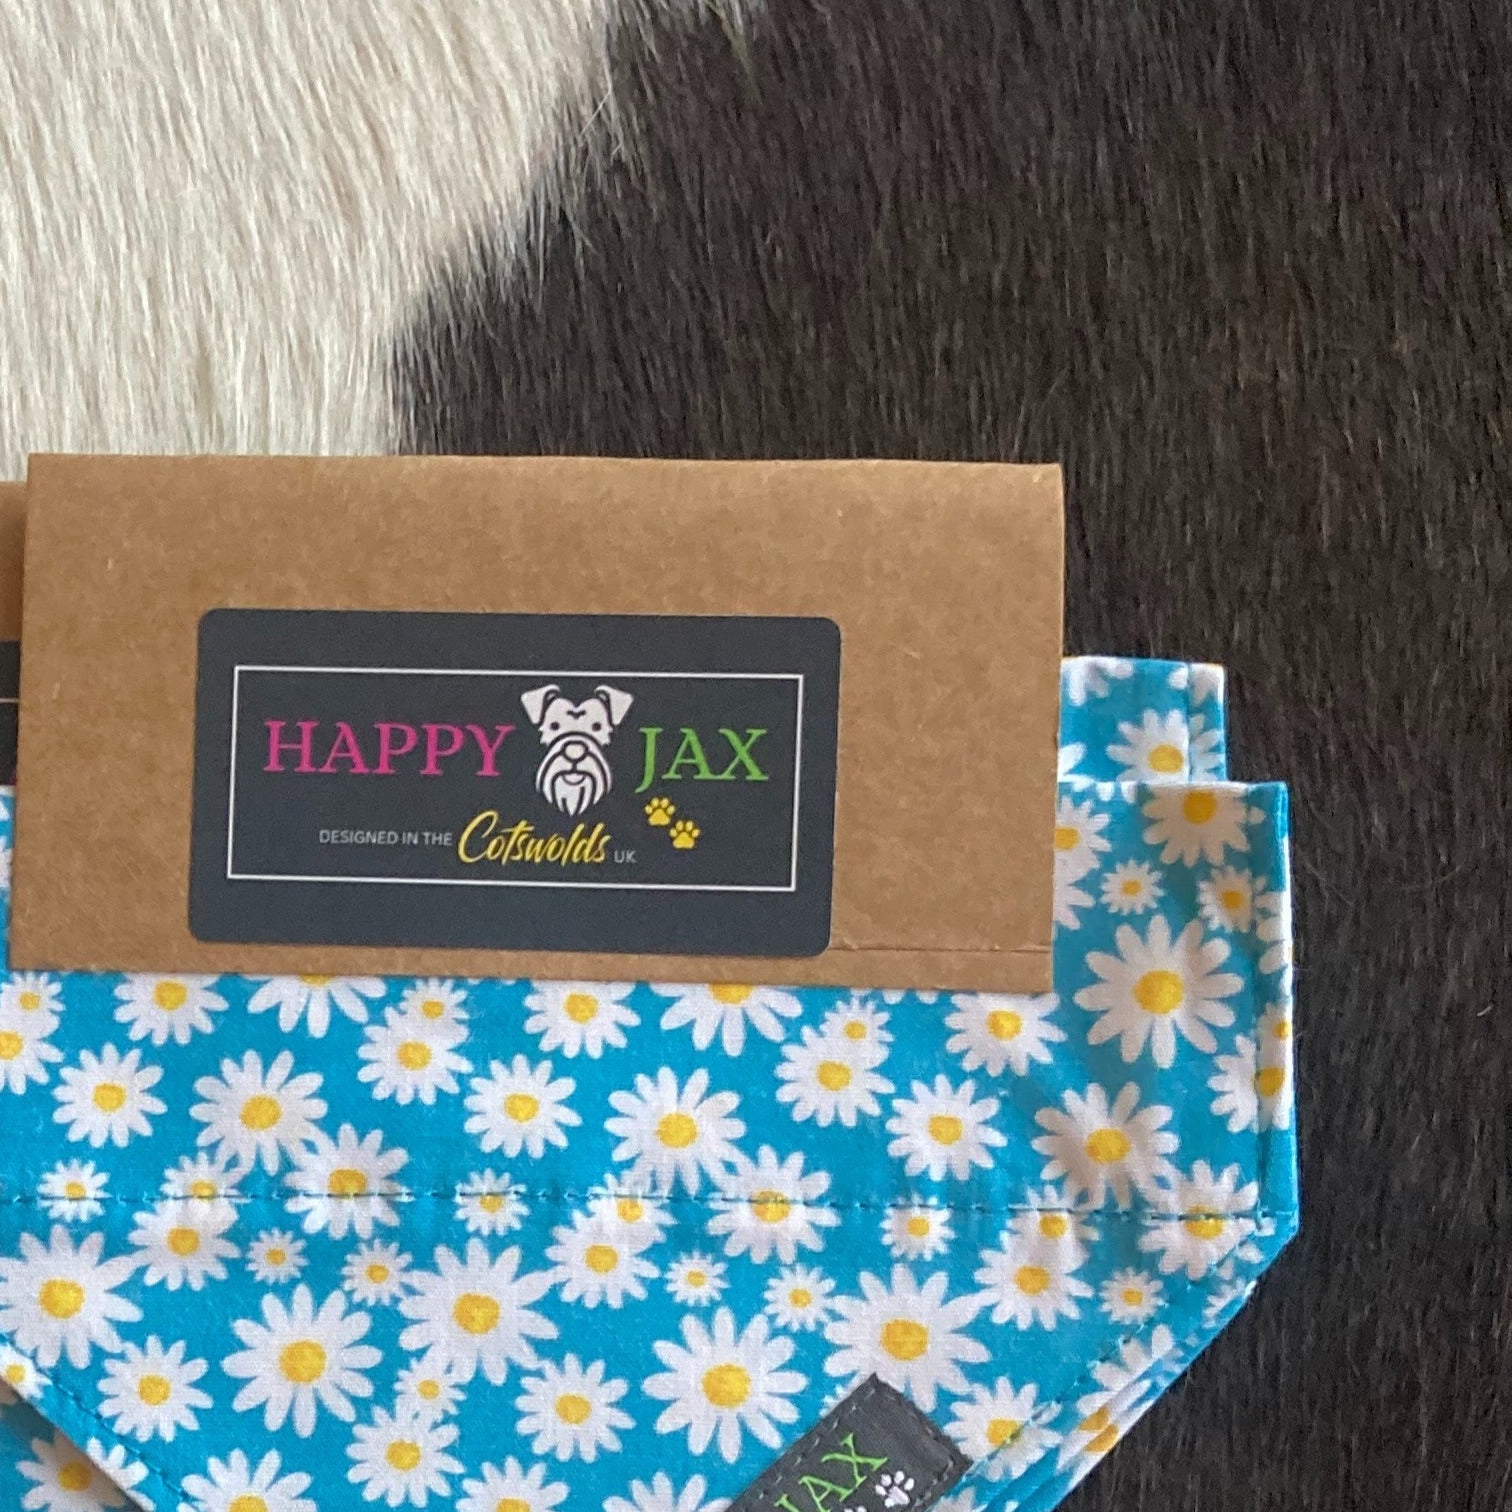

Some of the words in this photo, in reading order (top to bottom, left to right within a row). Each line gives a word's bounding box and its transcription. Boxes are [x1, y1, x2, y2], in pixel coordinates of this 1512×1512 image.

[263, 719, 516, 777] HAPPY
[634, 727, 770, 794] JAX
[318, 829, 398, 845] DESIGNED
[402, 831, 419, 845] IN
[423, 831, 453, 847] THE
[457, 809, 611, 867] Cotswolds
[614, 850, 637, 864] UK
